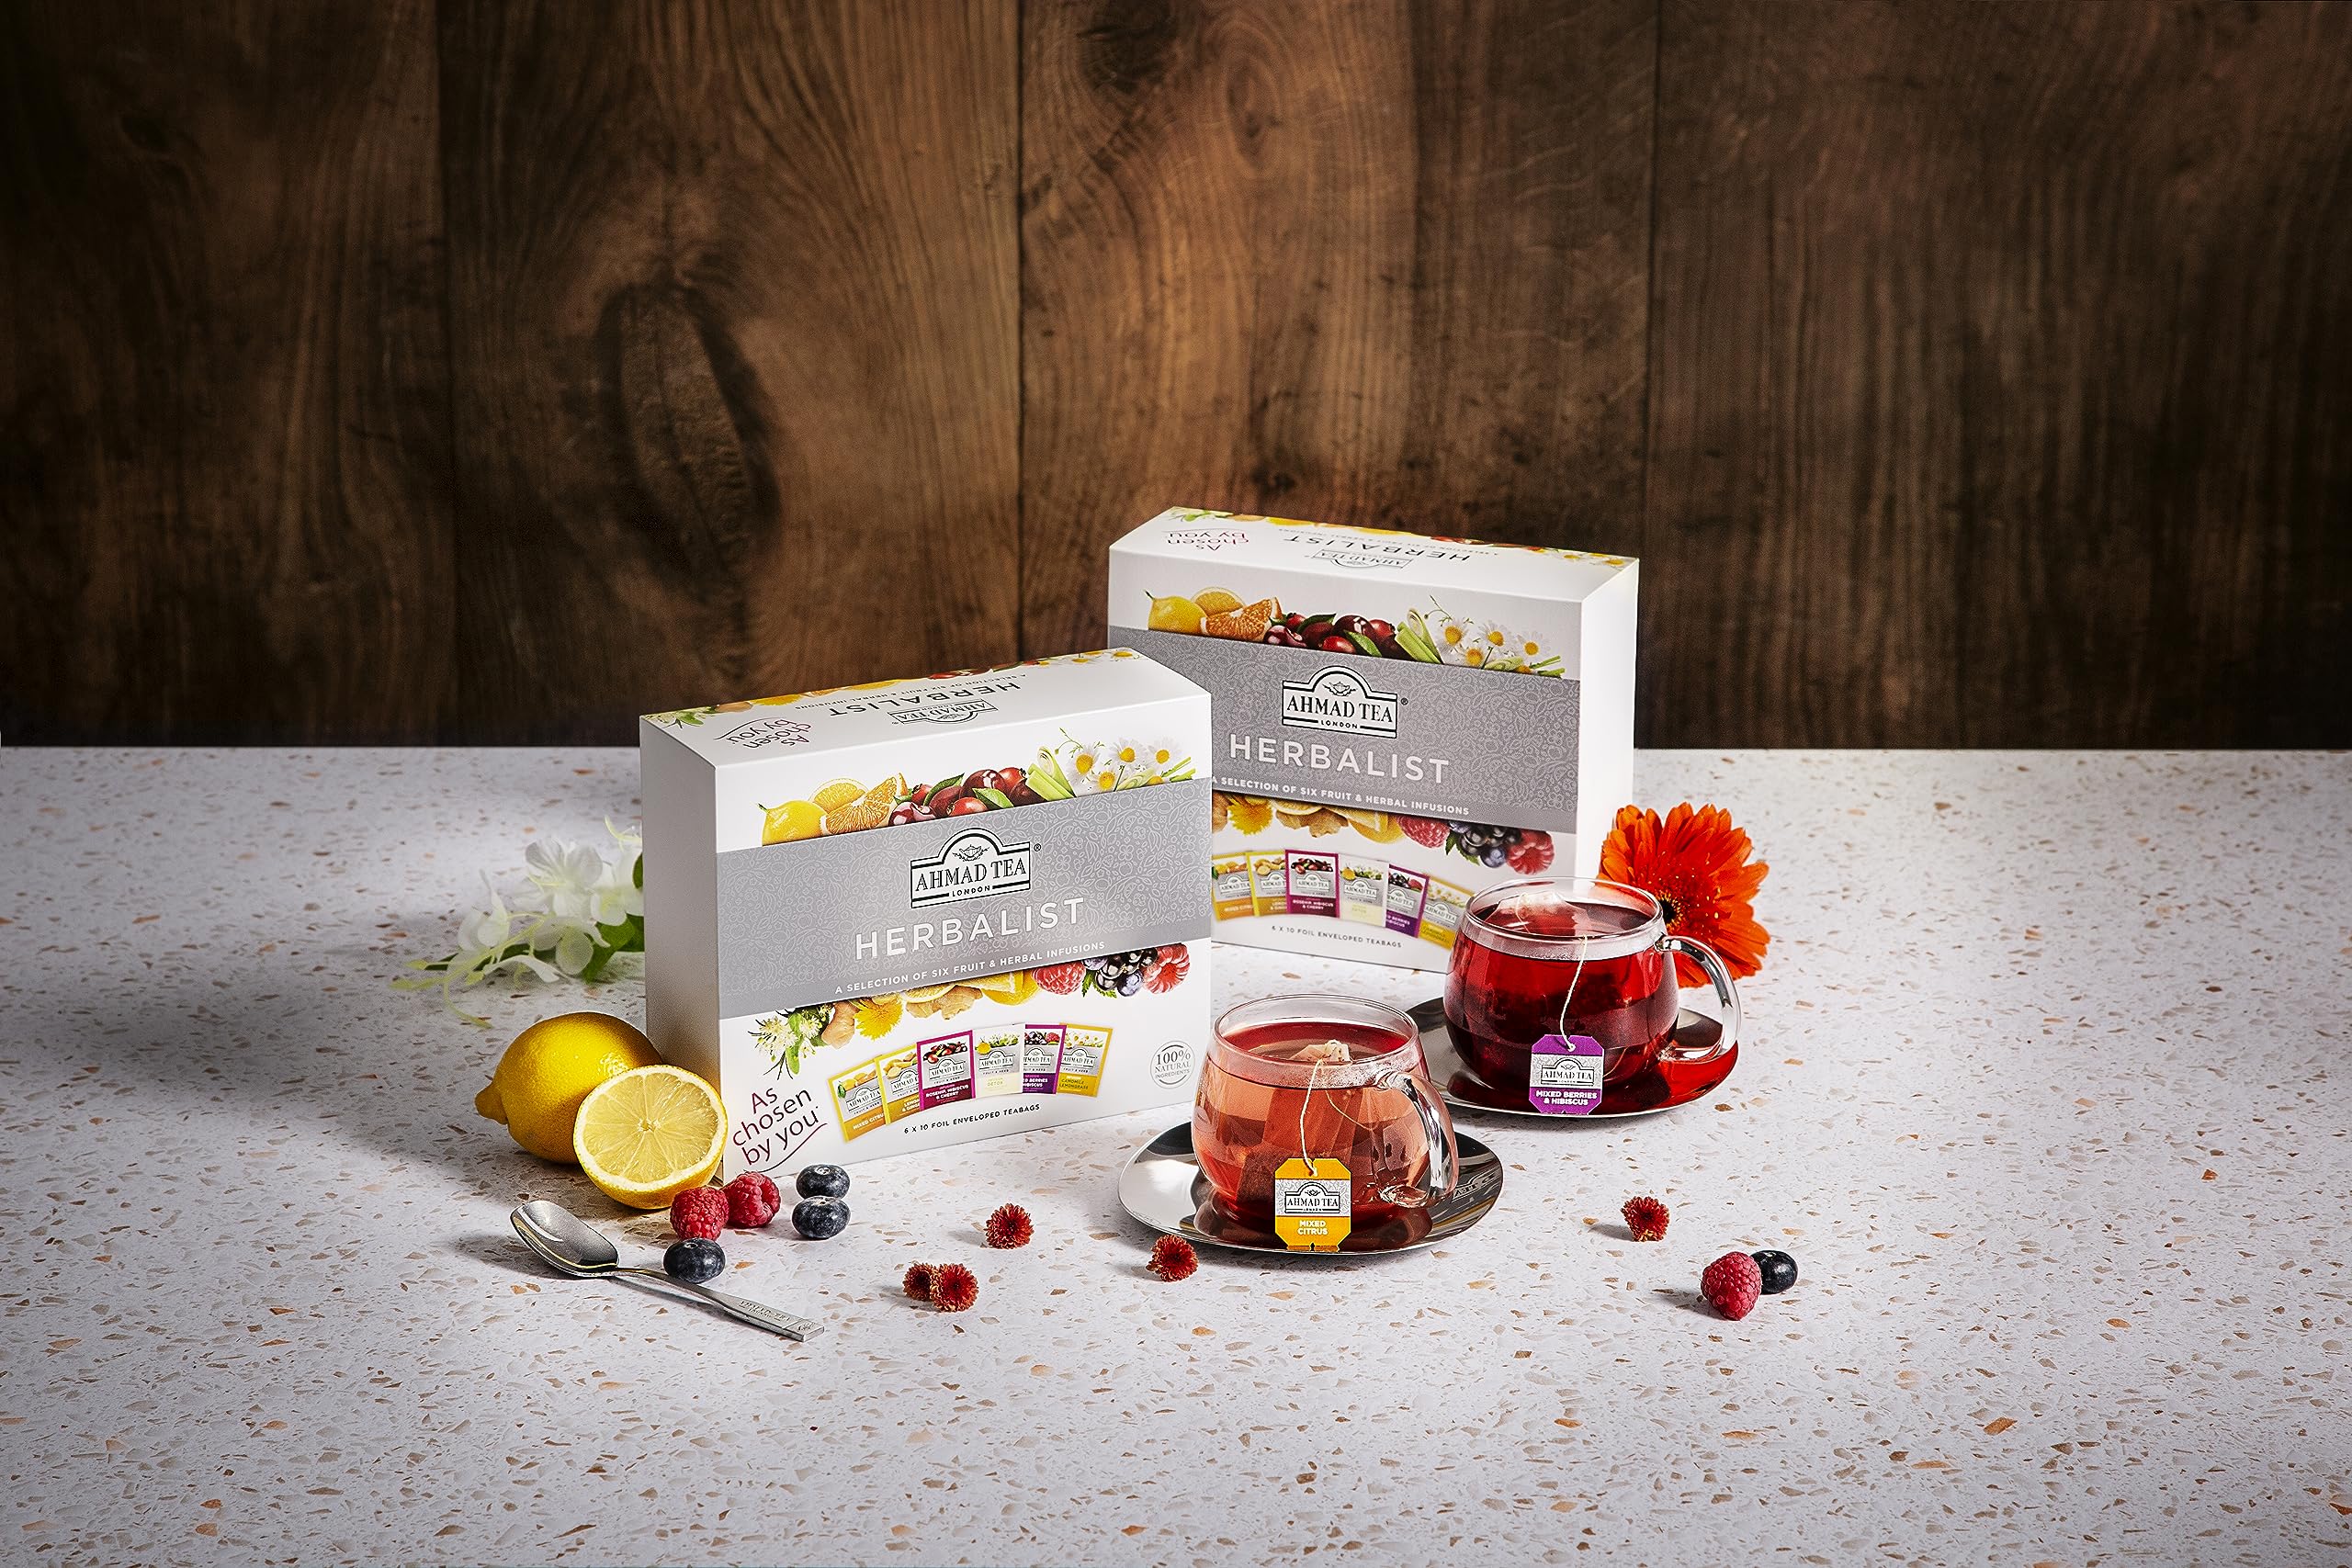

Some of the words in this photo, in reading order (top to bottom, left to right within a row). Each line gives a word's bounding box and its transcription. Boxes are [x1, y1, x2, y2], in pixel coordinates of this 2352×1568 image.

[1283, 535, 1471, 561] HERBALIST
[829, 682, 1022, 716] HERBALIST
[1286, 694, 1355, 718] AHMAD
[1359, 703, 1393, 723] TEA
[763, 719, 797, 730] by
[1321, 720, 1358, 728] LONDON
[726, 728, 768, 743] you
[742, 723, 811, 748] chosen
[781, 735, 809, 746] As
[1229, 734, 1449, 784] HERBALIST
[1221, 777, 1279, 792] SELECTION
[1283, 784, 1297, 795] OF
[1300, 786, 1317, 796] SIX
[1321, 790, 1352, 801] FRUIT
[1355, 794, 1363, 802] &
[1366, 795, 1408, 808] HERBAL
[1411, 801, 1469, 816] INFUSIONS
[915, 863, 987, 892] AHMAD
[990, 858, 1026, 879] TEA
[952, 885, 990, 897] LONDON
[854, 897, 1084, 960] HERBALIST
[1317, 931, 1363, 943] ENVELOPED
[1366, 938, 1402, 948] TEABAGS
[834, 986, 842, 995] A
[847, 975, 909, 992] SELECTION
[912, 971, 928, 981] OF
[932, 967, 949, 978] SIX
[954, 962, 986, 976] FRUIT
[989, 959, 996, 967] &
[1000, 953, 1043, 965] HERBAL
[1046, 942, 1105, 958] INFUSIONS
[1157, 1048, 1191, 1065] 100%
[1154, 1068, 1191, 1078] INGREDIENTS
[1155, 1061, 1192, 1074] NATURAL
[1544, 1070, 1575, 1078] AHMAD
[1576, 1071, 1592, 1079] TEA
[752, 1088, 777, 1114] As
[1563, 1091, 1598, 1100] BERRIES
[732, 1089, 812, 1146] chosen
[869, 1113, 885, 1122] CITRU
[931, 1121, 950, 1129] FOIL
[953, 1111, 1001, 1125] ENVELOPED
[1003, 1103, 1041, 1116] TEABAGS
[741, 1137, 771, 1166] by
[775, 1110, 819, 1150] you
[1287, 1198, 1320, 1206] AHMAD
[1321, 1198, 1338, 1206] TEA
